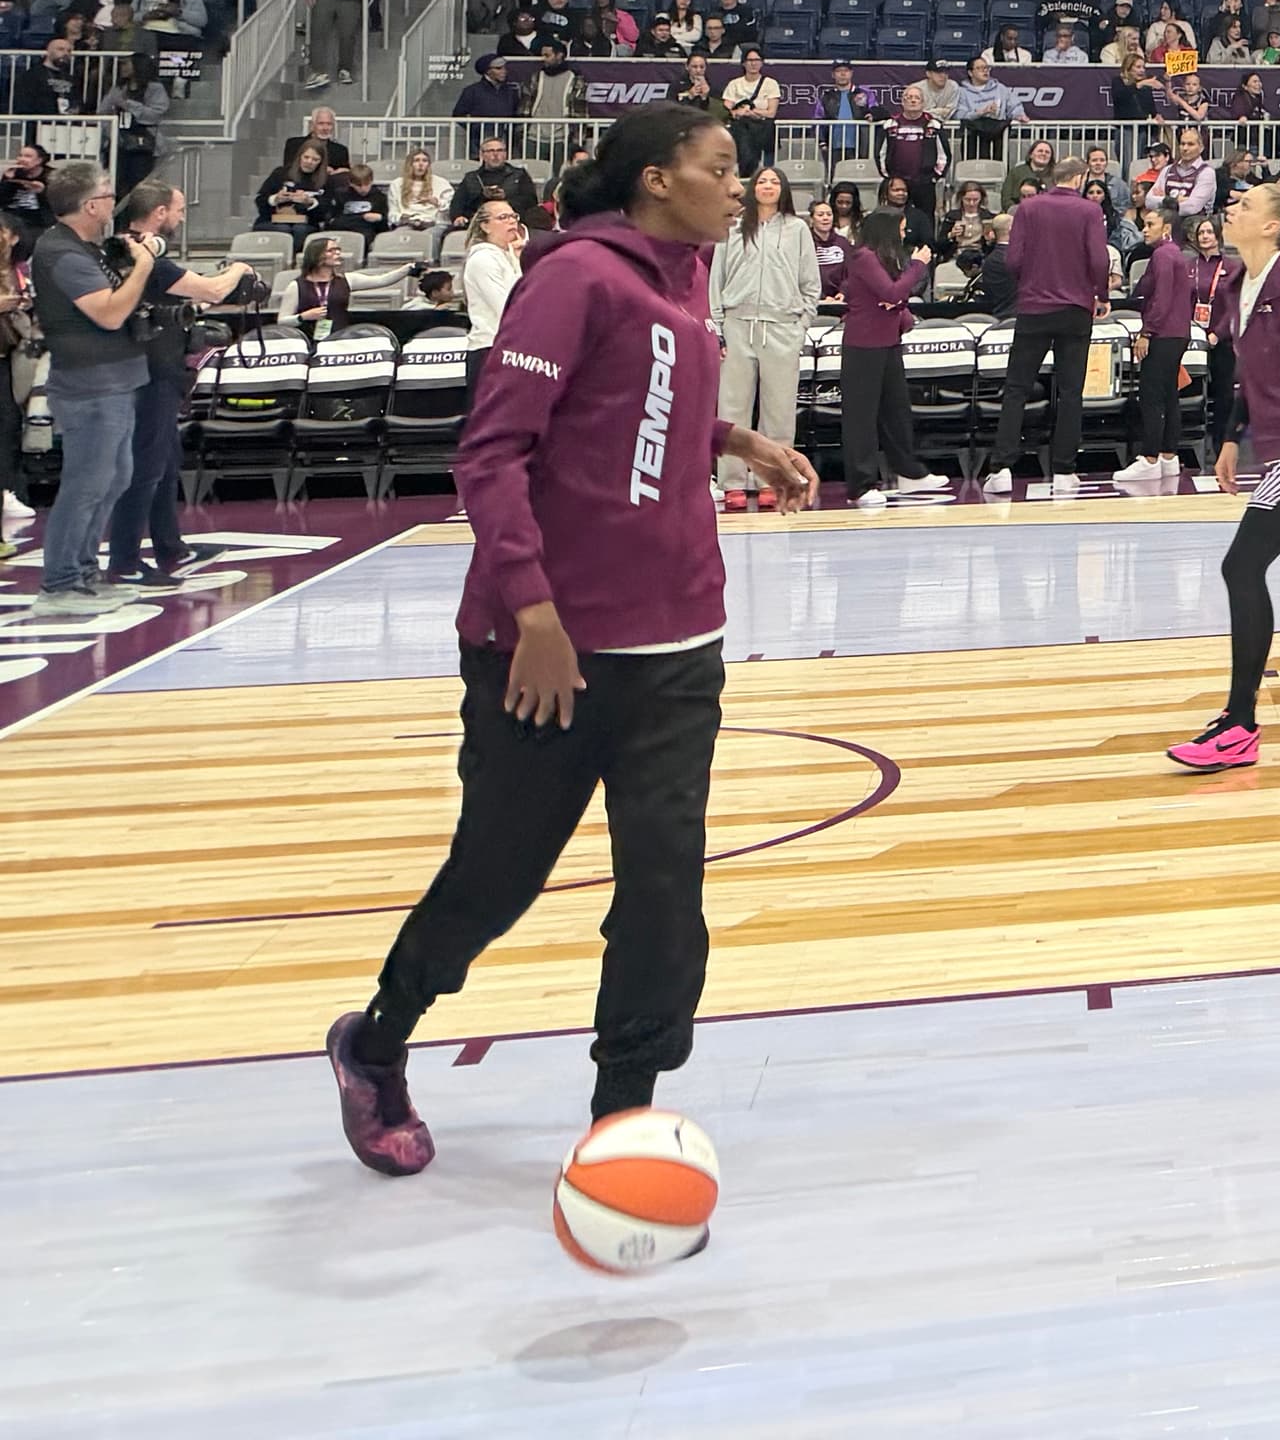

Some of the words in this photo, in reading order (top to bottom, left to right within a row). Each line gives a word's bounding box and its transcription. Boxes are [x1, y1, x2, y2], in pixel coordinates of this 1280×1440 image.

[908, 341, 965, 354] SEPHORA
[320, 352, 383, 366] SEPHORA
[501, 349, 562, 380] TAMPAX
[630, 322, 676, 507] TEMPO
